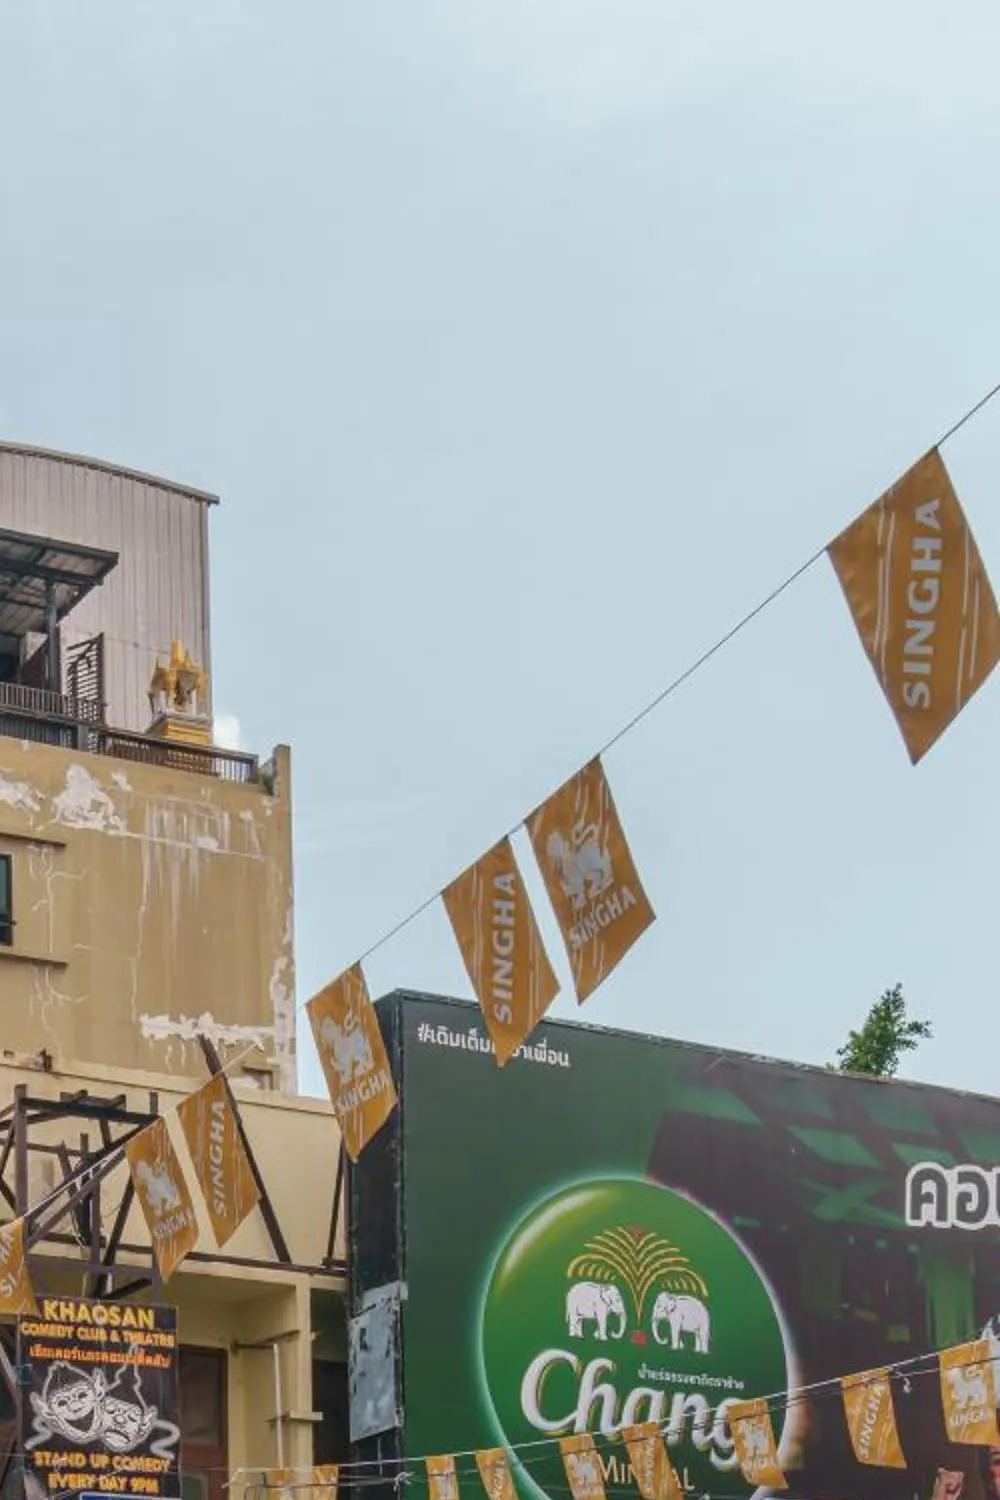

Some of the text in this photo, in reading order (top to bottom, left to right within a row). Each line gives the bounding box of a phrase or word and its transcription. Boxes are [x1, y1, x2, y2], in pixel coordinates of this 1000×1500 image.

[902, 499, 944, 710] SINGHA
[494, 871, 516, 1025] SINGHA
[568, 885, 637, 951] SINGHA
[905, 1162, 1000, 1231] คอ
[44, 1299, 155, 1330] KHAOSAN
